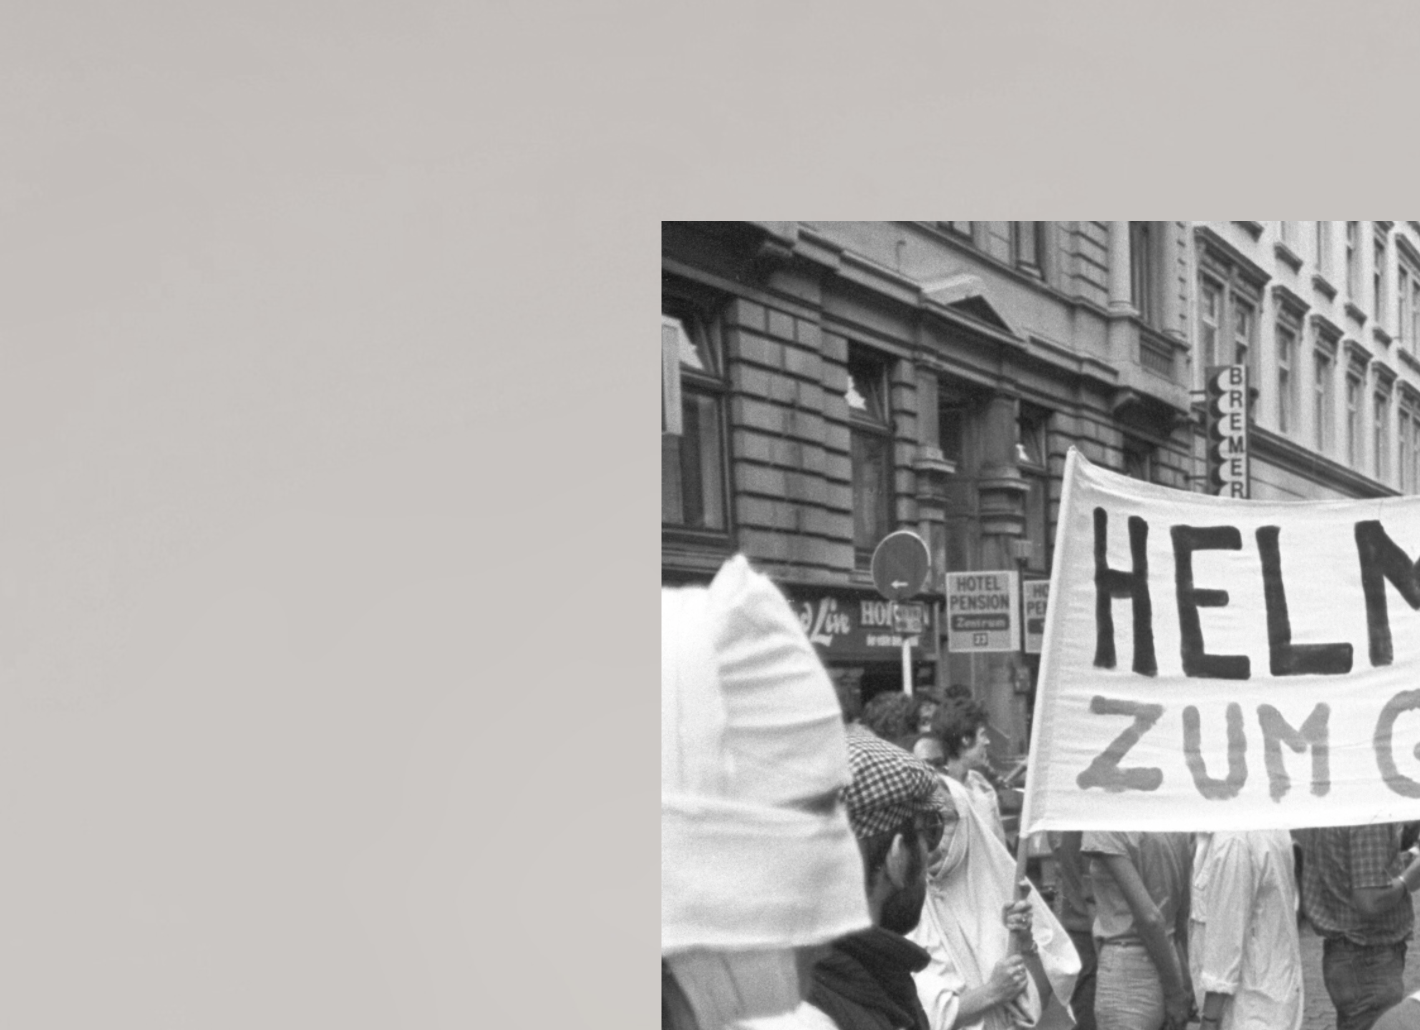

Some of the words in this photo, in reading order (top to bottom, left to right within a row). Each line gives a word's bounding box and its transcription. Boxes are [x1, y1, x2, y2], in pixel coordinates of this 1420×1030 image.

[1228, 367, 1244, 498] BREMER
[950, 594, 1009, 611] PENSION
[957, 575, 1001, 592] HOTEL
[1076, 695, 1331, 802] ZUM
